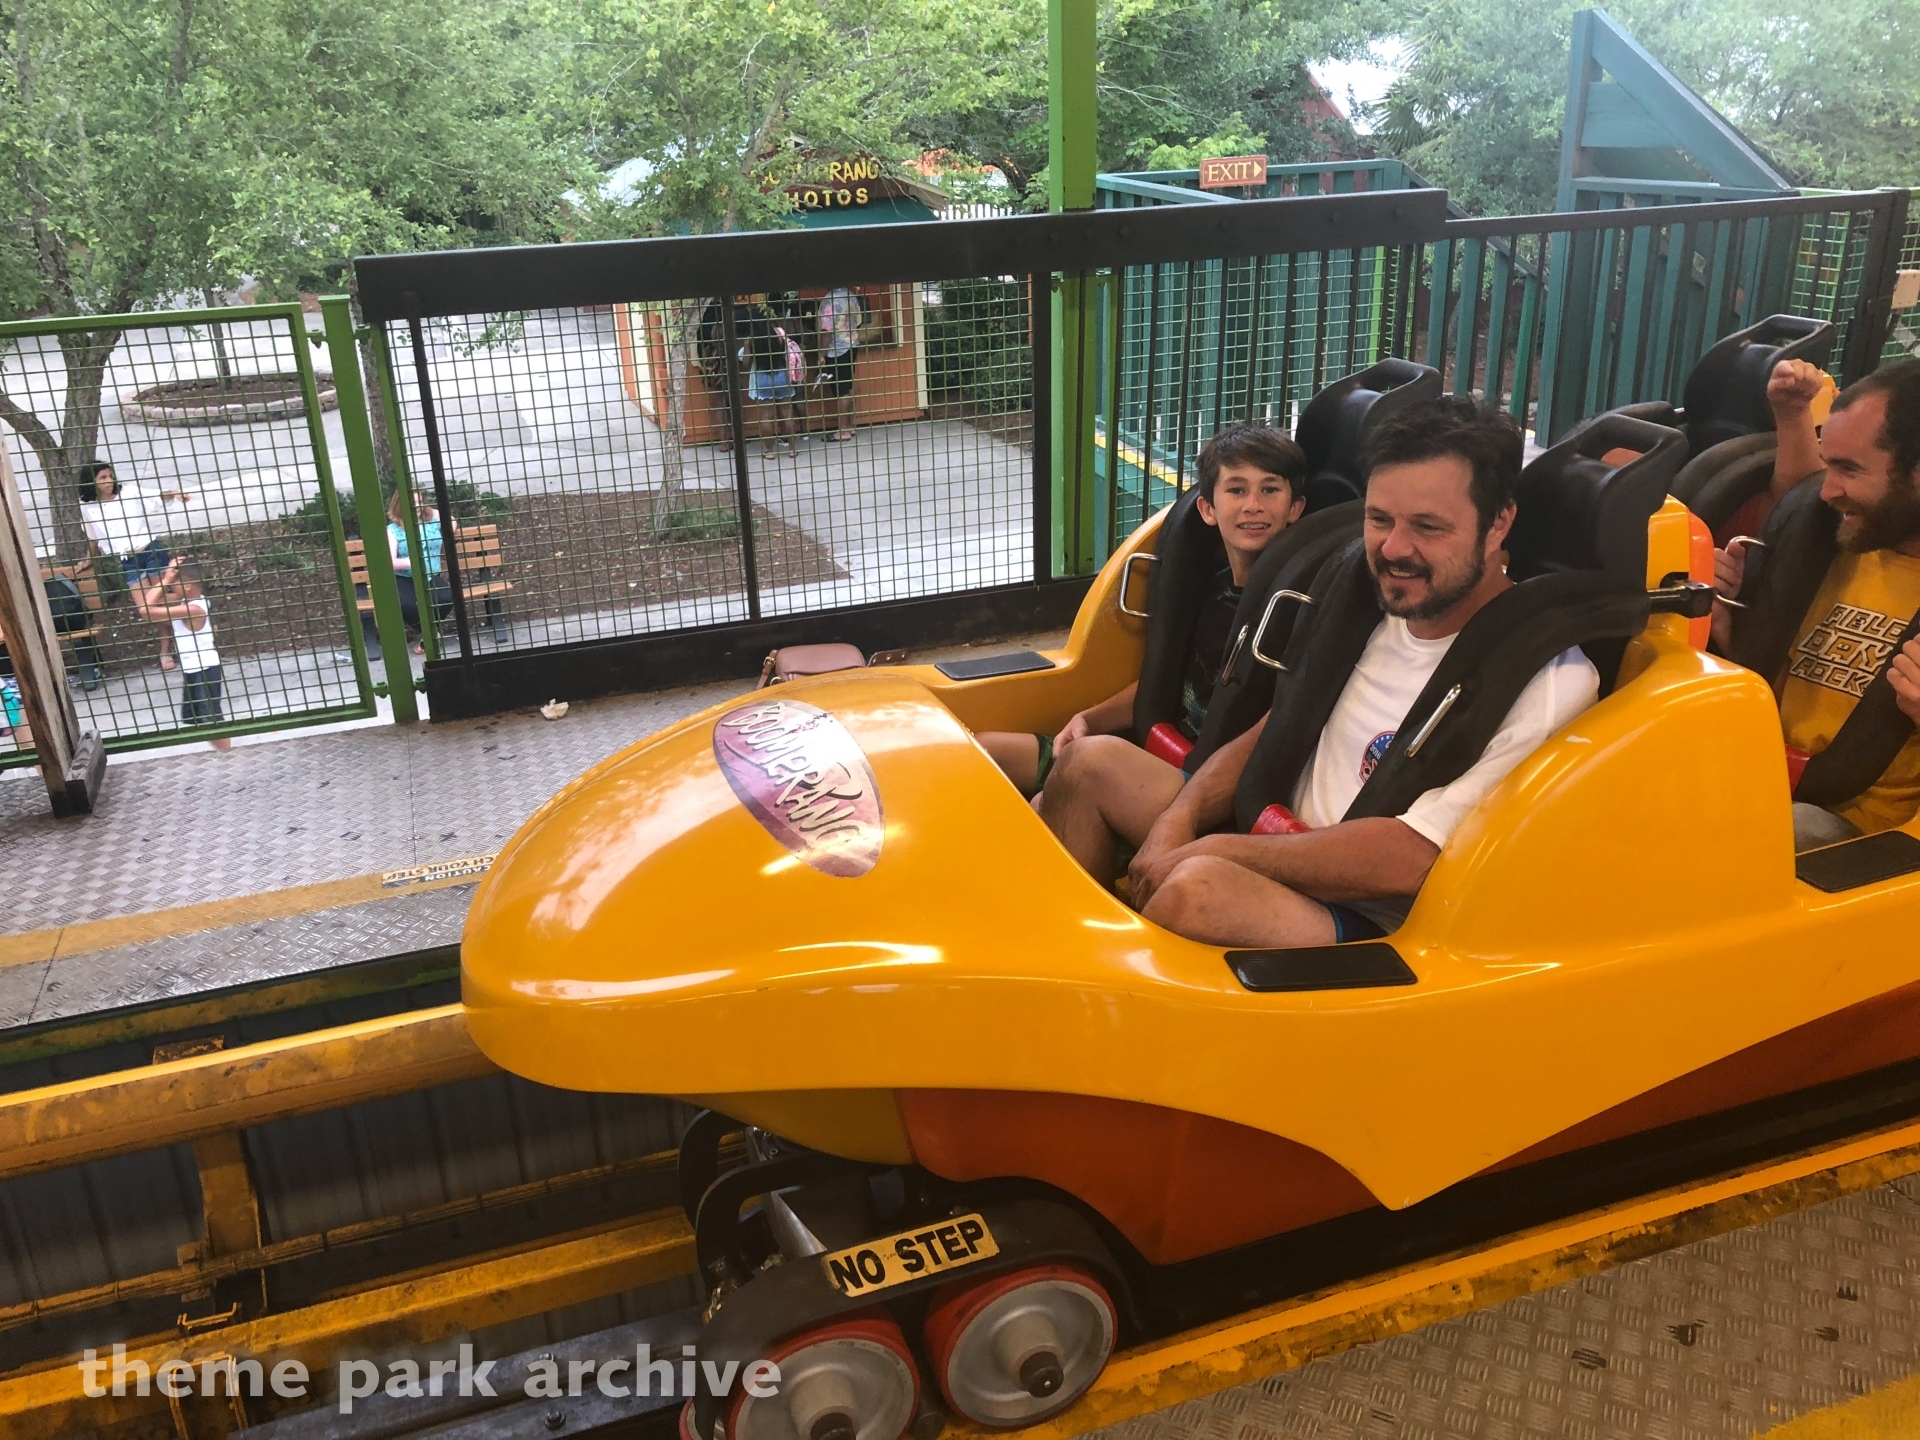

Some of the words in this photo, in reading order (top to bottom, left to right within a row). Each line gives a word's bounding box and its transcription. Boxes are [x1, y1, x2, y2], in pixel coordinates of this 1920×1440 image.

[1207, 161, 1252, 182] EXIT
[784, 186, 869, 209] HOTOS
[1798, 625, 1893, 674] DAY
[1789, 653, 1876, 698] ROCK
[428, 861, 469, 873] YOUR
[828, 1249, 887, 1293] NO
[894, 1219, 984, 1274] STEP
